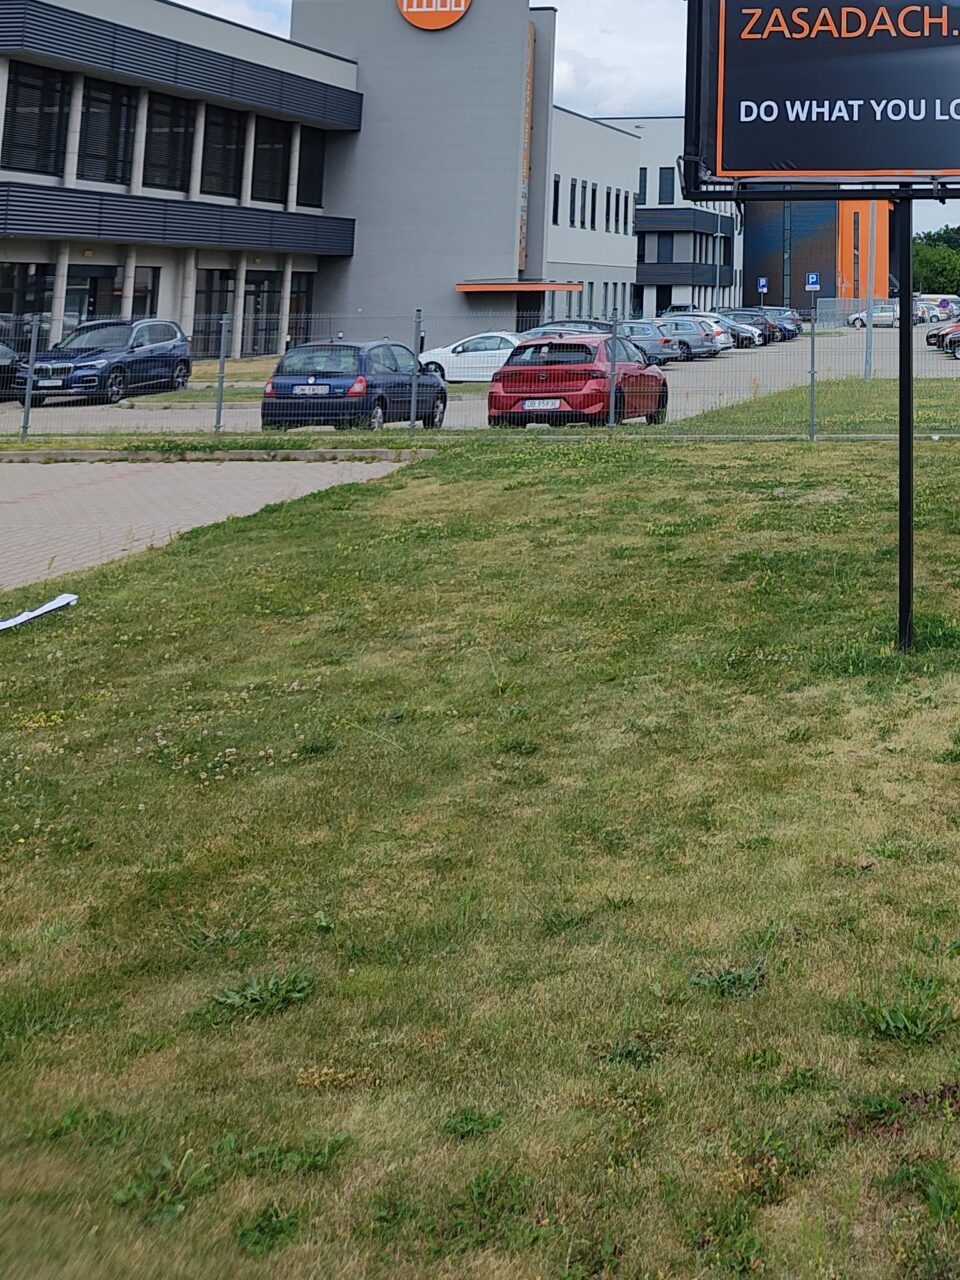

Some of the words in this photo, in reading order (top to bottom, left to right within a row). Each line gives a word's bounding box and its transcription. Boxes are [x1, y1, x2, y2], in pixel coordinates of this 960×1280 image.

[740, 5, 960, 39] ZASADACH.
[739, 100, 779, 122] DO
[786, 99, 864, 122] WHAT
[870, 98, 926, 121] YOU
